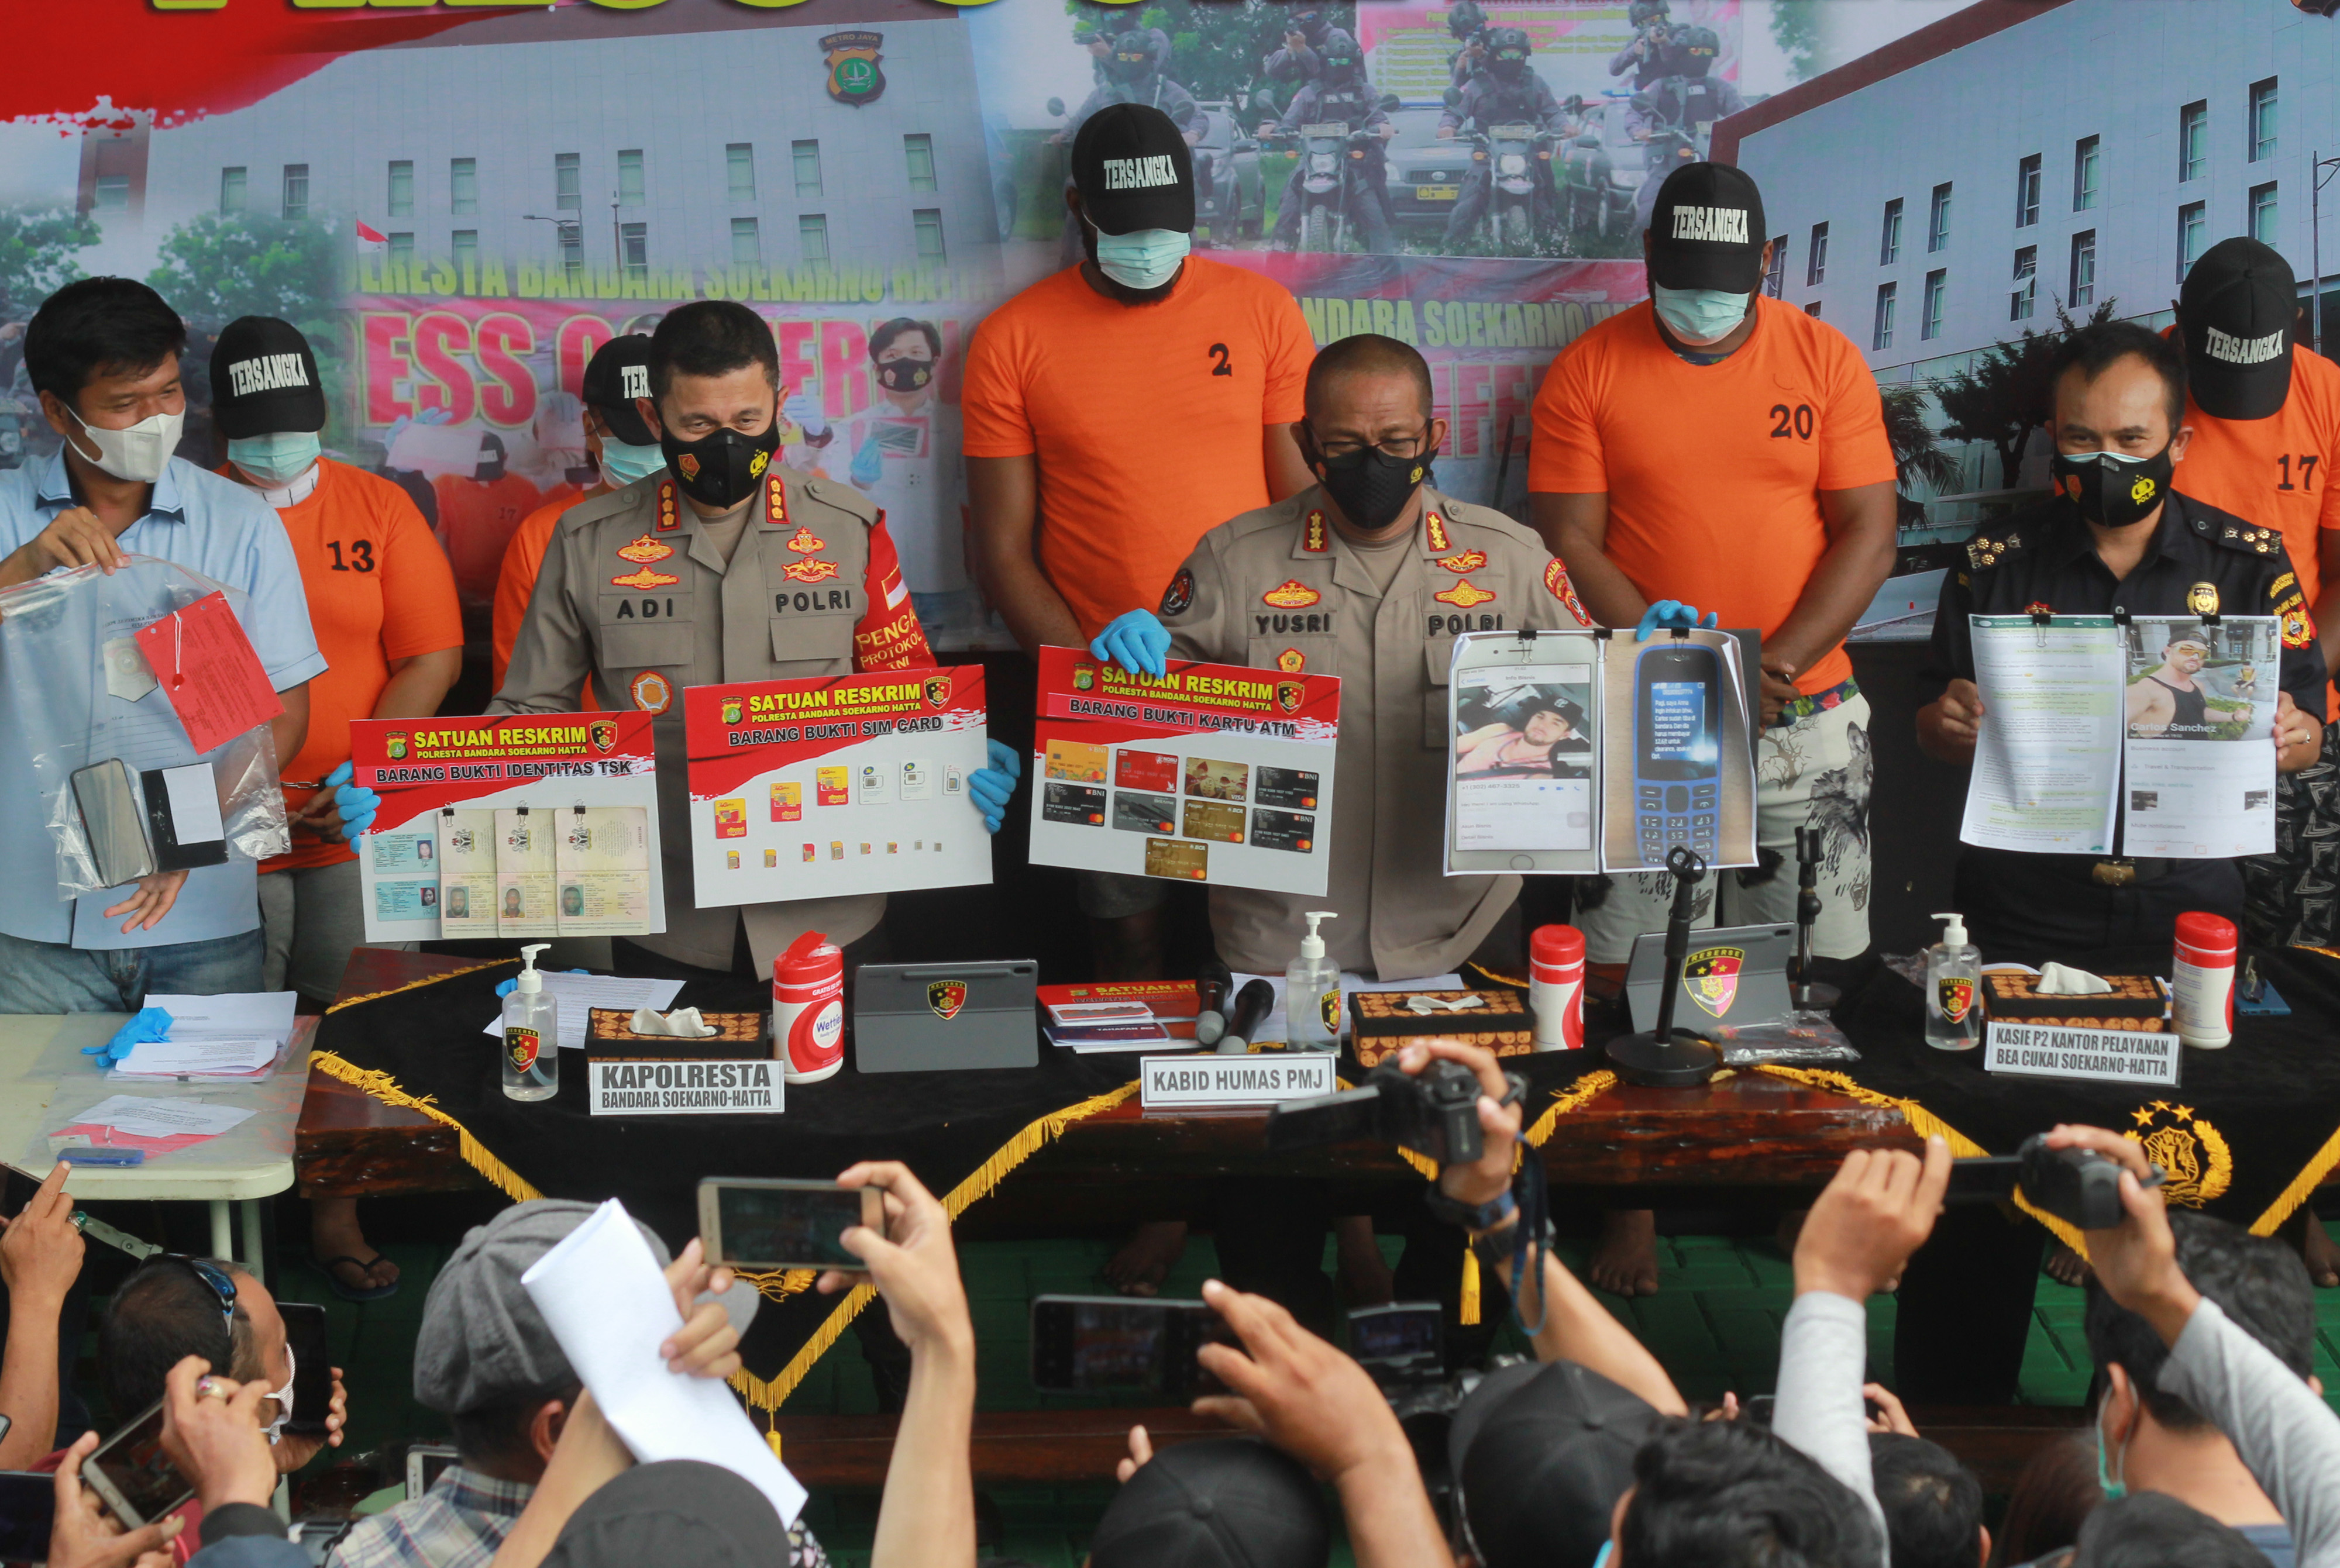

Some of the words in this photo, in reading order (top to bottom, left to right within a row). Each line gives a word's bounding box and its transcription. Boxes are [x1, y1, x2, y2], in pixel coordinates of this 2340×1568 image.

[825, 34, 855, 44] METRO
[1104, 155, 1178, 189] TERSANGKA
[1673, 206, 1749, 243] TERSANGKA
[1423, 301, 1587, 347] SOEKARNO
[2206, 326, 2283, 364] TERSANGKA
[1209, 343, 1232, 377] 2
[229, 353, 309, 397] TERSANGKA
[621, 365, 653, 398] TER
[1770, 404, 1813, 440] 20
[682, 471, 693, 482] TNI
[2277, 454, 2318, 491] 17
[2136, 491, 2156, 505] POLRI
[327, 539, 375, 573] 13
[1547, 561, 1562, 587] POLDA
[617, 598, 673, 619] ADI
[776, 590, 851, 614] POLRI
[1255, 613, 1330, 635] YUSRI
[1428, 613, 1503, 636] POLRI
[860, 631, 922, 668] PROTOKOL
[886, 656, 910, 670] TNI
[1102, 666, 1180, 690] SATUAN
[1186, 676, 1274, 701] RESKRIM
[749, 692, 828, 712] SATUAN
[835, 683, 921, 704] RESKRIM
[1102, 685, 1148, 698] POLRESTA
[1150, 690, 1191, 702] BANDARA
[1193, 694, 1241, 708] SOEKARNO
[1242, 700, 1272, 711] HATTA
[751, 712, 797, 723] POLRESTA
[799, 708, 841, 720] BANDARA
[842, 705, 890, 717] SOEKARNO
[892, 702, 921, 712] HATTA
[1069, 699, 1138, 719] BARANG
[1143, 707, 1195, 726] BUKTI
[1199, 714, 1255, 733] KARTU
[1260, 722, 1296, 737] ATM
[414, 728, 494, 748] SATUAN
[500, 726, 587, 745] RESKRIM
[728, 726, 800, 746] BARANG
[804, 723, 857, 740] BUKTI
[862, 719, 893, 735] SIM
[897, 716, 943, 732] CARD
[2131, 722, 2167, 732] Carlos
[2170, 723, 2217, 733] Sanchez
[417, 748, 463, 759] POLRESTA
[464, 747, 506, 758] BANDARA
[508, 746, 556, 756] SOEKARNO
[558, 745, 587, 755] HATTA
[376, 766, 446, 783] BARANG
[450, 763, 501, 780] BUKTI
[506, 761, 594, 778] IDENTITAS
[597, 760, 632, 775] TSK
[1691, 950, 1740, 962] RESERSE
[812, 985, 830, 996] GRATIS
[1095, 984, 1171, 993] SATUAN
[508, 1028, 537, 1036] RESERSE
[817, 1014, 842, 1032] Wetties
[1996, 1028, 2031, 1047] KASIE
[2033, 1031, 2048, 1047] P2
[2051, 1032, 2099, 1052] KANTOR
[2101, 1036, 2169, 1056] PELAYANAN
[1997, 1049, 2019, 1065] BEA
[2022, 1050, 2059, 1069] CUKAI
[2061, 1053, 2168, 1077] SOEKARNO-HATTA
[602, 1063, 771, 1090] KAPOLRESTA
[1154, 1070, 1210, 1092] KABID
[1216, 1069, 1281, 1091] HUMAS
[1287, 1068, 1323, 1090] PMJ
[602, 1090, 660, 1108] BANDARA
[662, 1088, 772, 1108] SOEKARNO-HATTA
